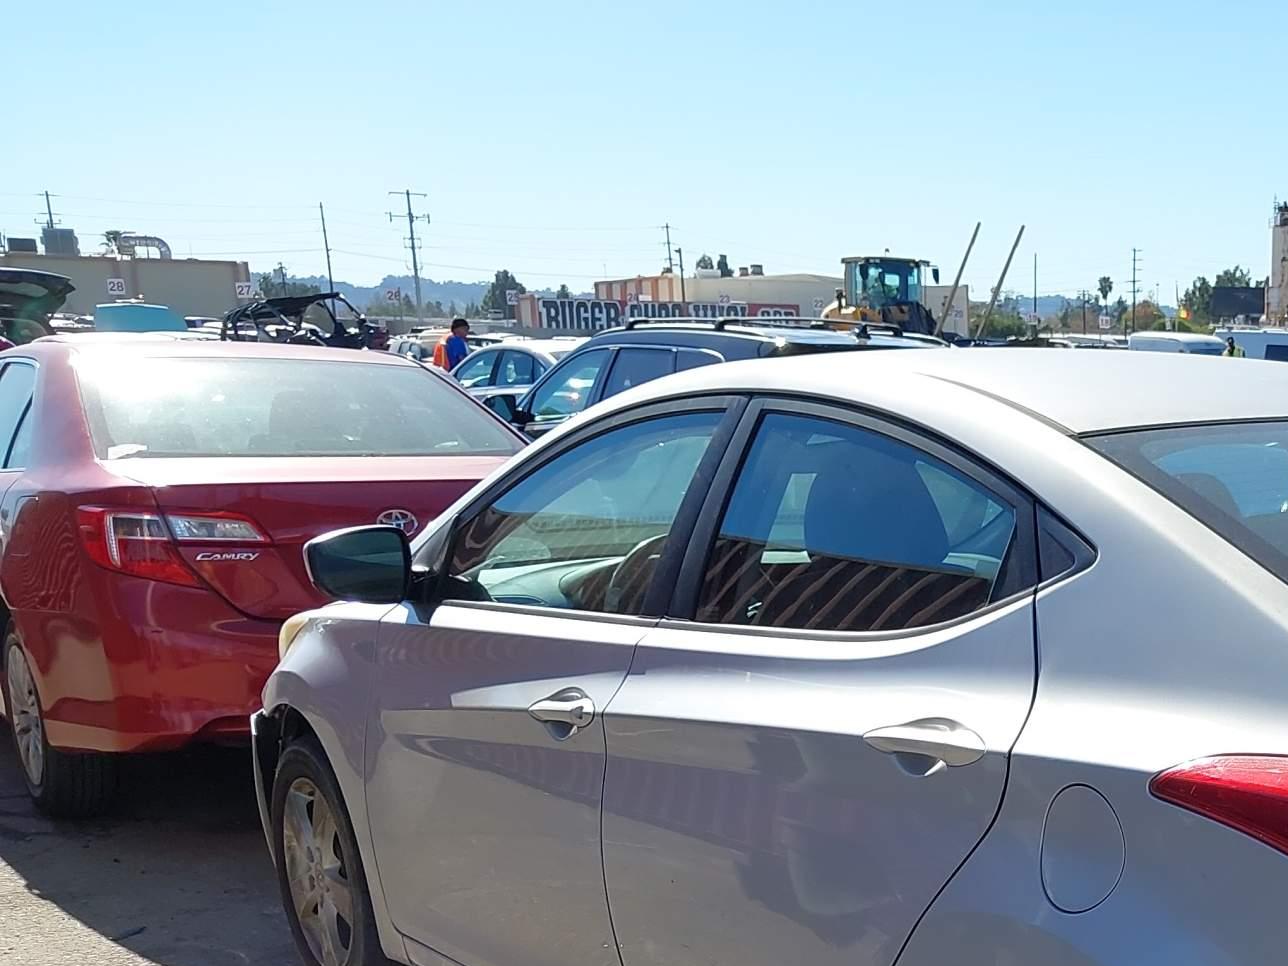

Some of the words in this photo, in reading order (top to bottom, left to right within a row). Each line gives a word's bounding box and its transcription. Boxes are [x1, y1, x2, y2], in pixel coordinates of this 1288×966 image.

[108, 281, 124, 292] 28
[237, 285, 250, 296] 27
[719, 295, 730, 304] 23
[195, 552, 260, 561] CAMRY
